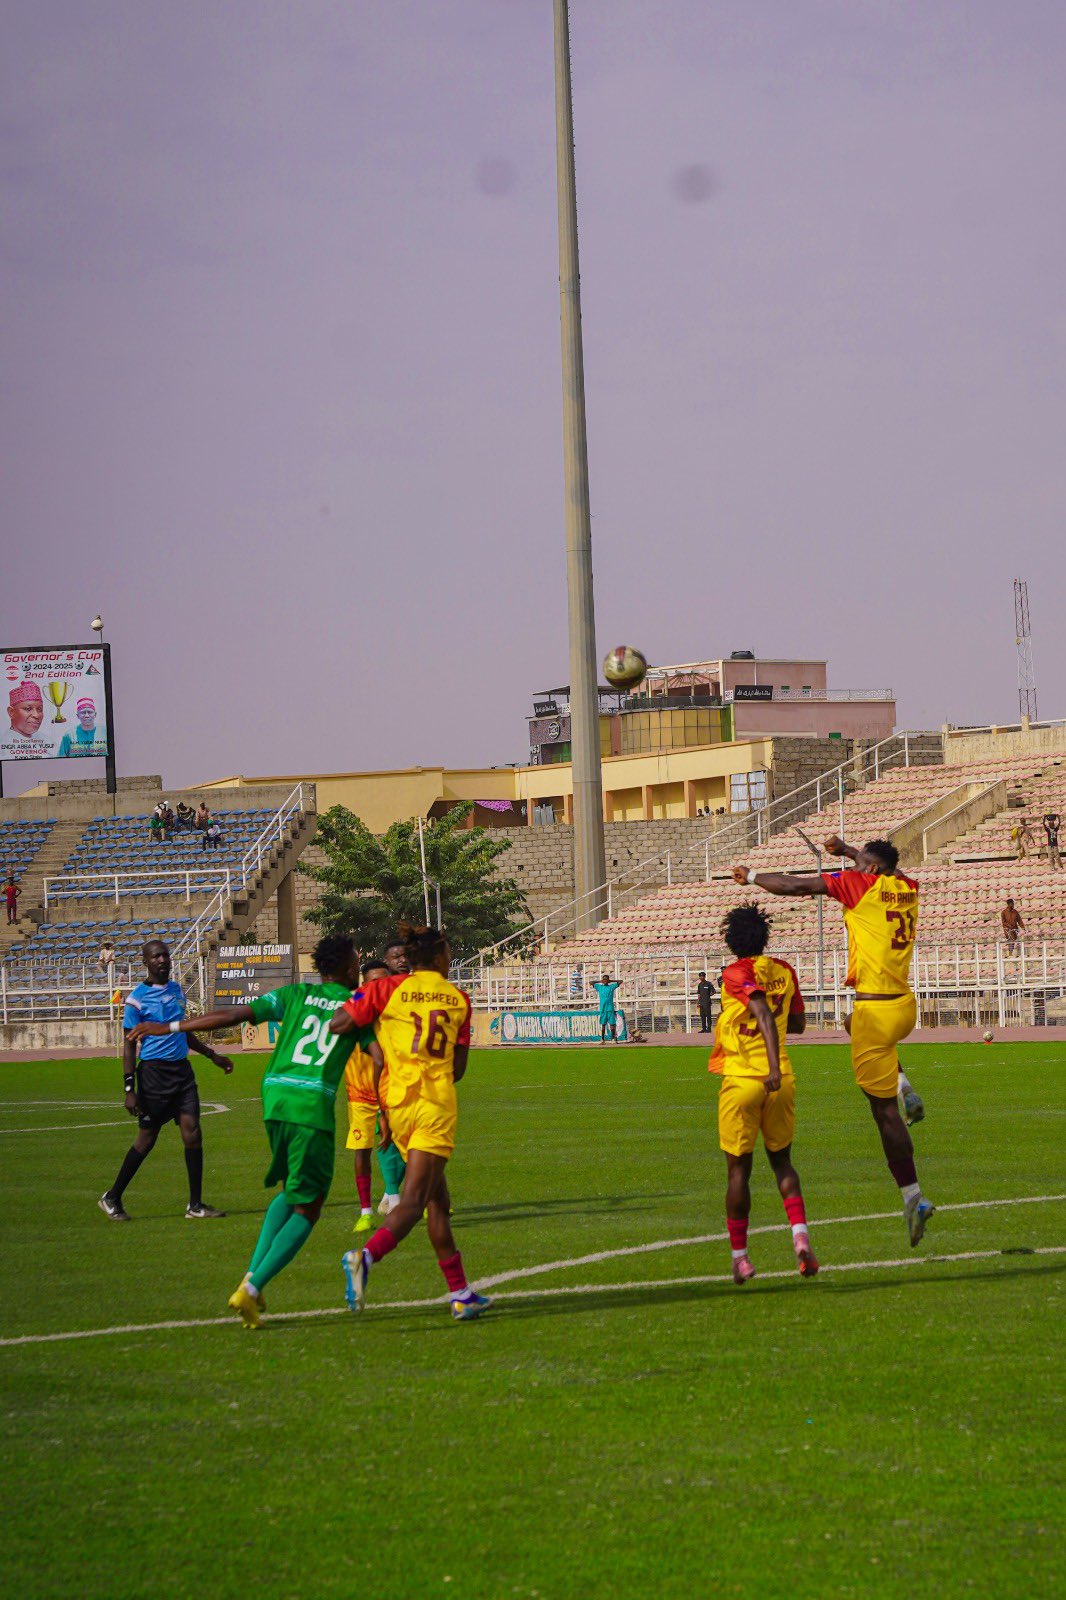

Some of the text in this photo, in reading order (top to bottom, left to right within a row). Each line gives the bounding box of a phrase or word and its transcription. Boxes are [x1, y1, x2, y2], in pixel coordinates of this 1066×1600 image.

[5, 651, 101, 662] Governor's Cup
[25, 670, 82, 679] 2nd Edition
[219, 944, 291, 957] SANI ABACHA STADIUM
[245, 955, 281, 964] SCORE BOARD
[248, 982, 260, 991] VS
[410, 1009, 450, 1059] 16
